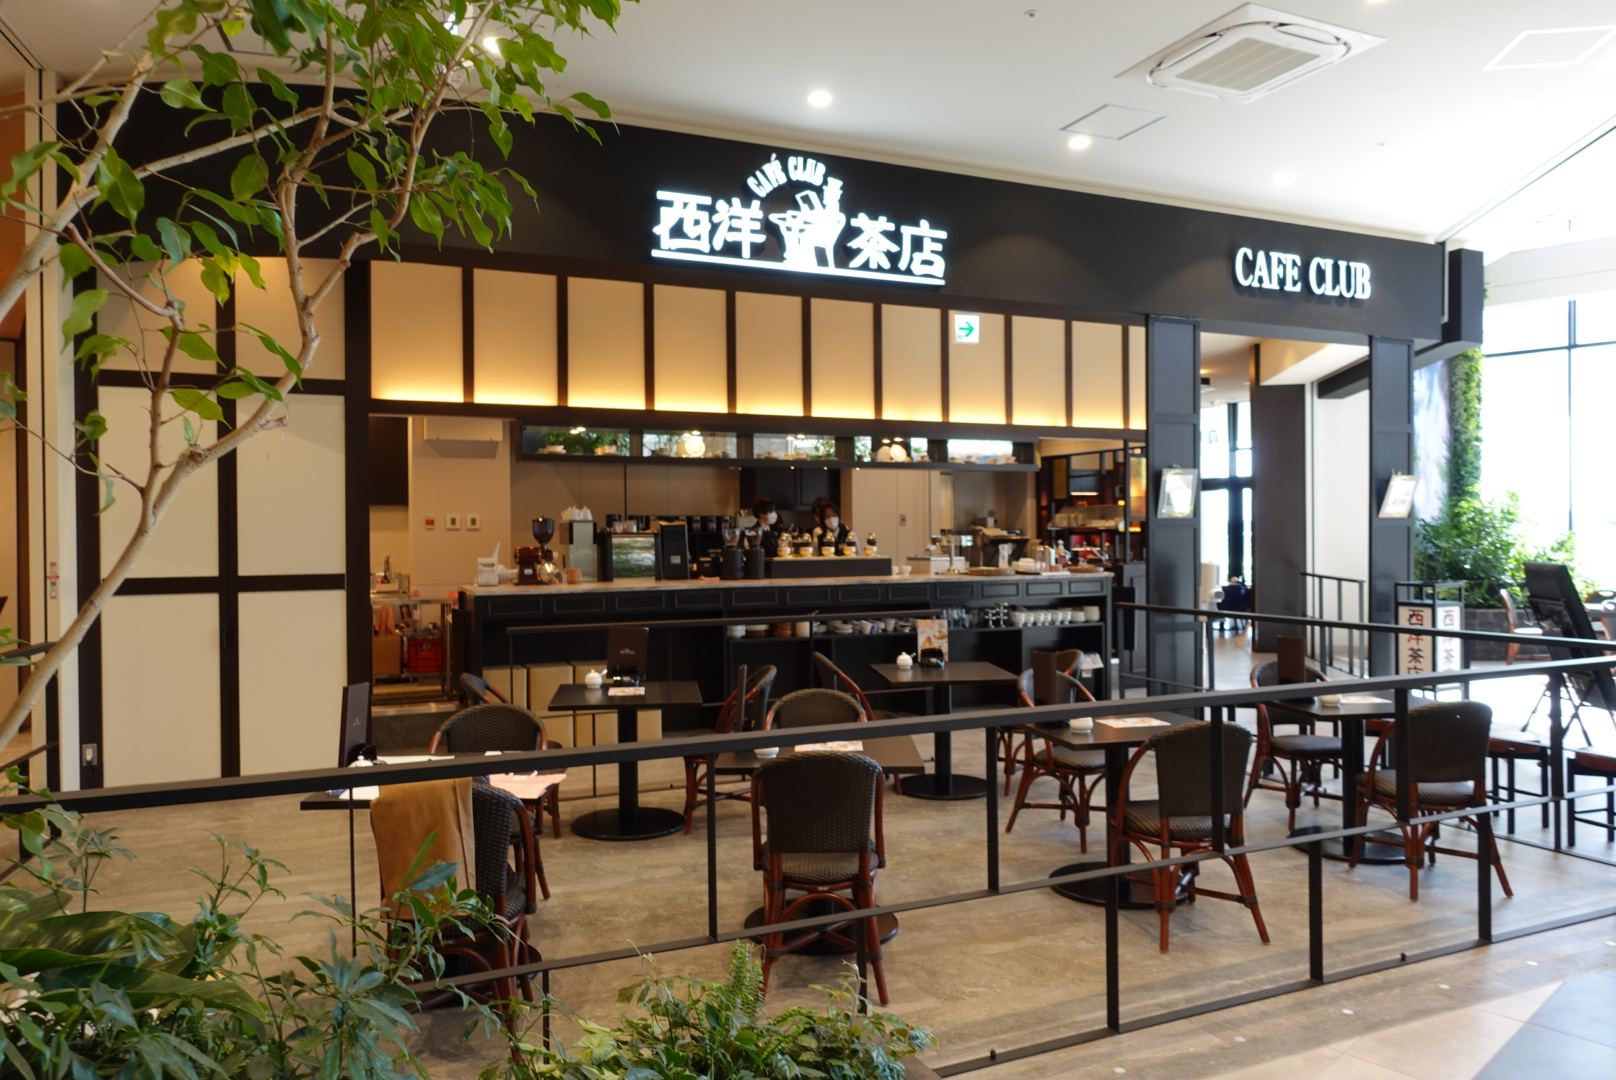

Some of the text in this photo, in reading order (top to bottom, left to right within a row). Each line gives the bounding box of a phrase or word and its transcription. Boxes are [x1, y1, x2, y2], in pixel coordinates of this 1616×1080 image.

[747, 153, 826, 198] CAFÉ CLUB
[1235, 247, 1373, 299] CAFE CLUB
